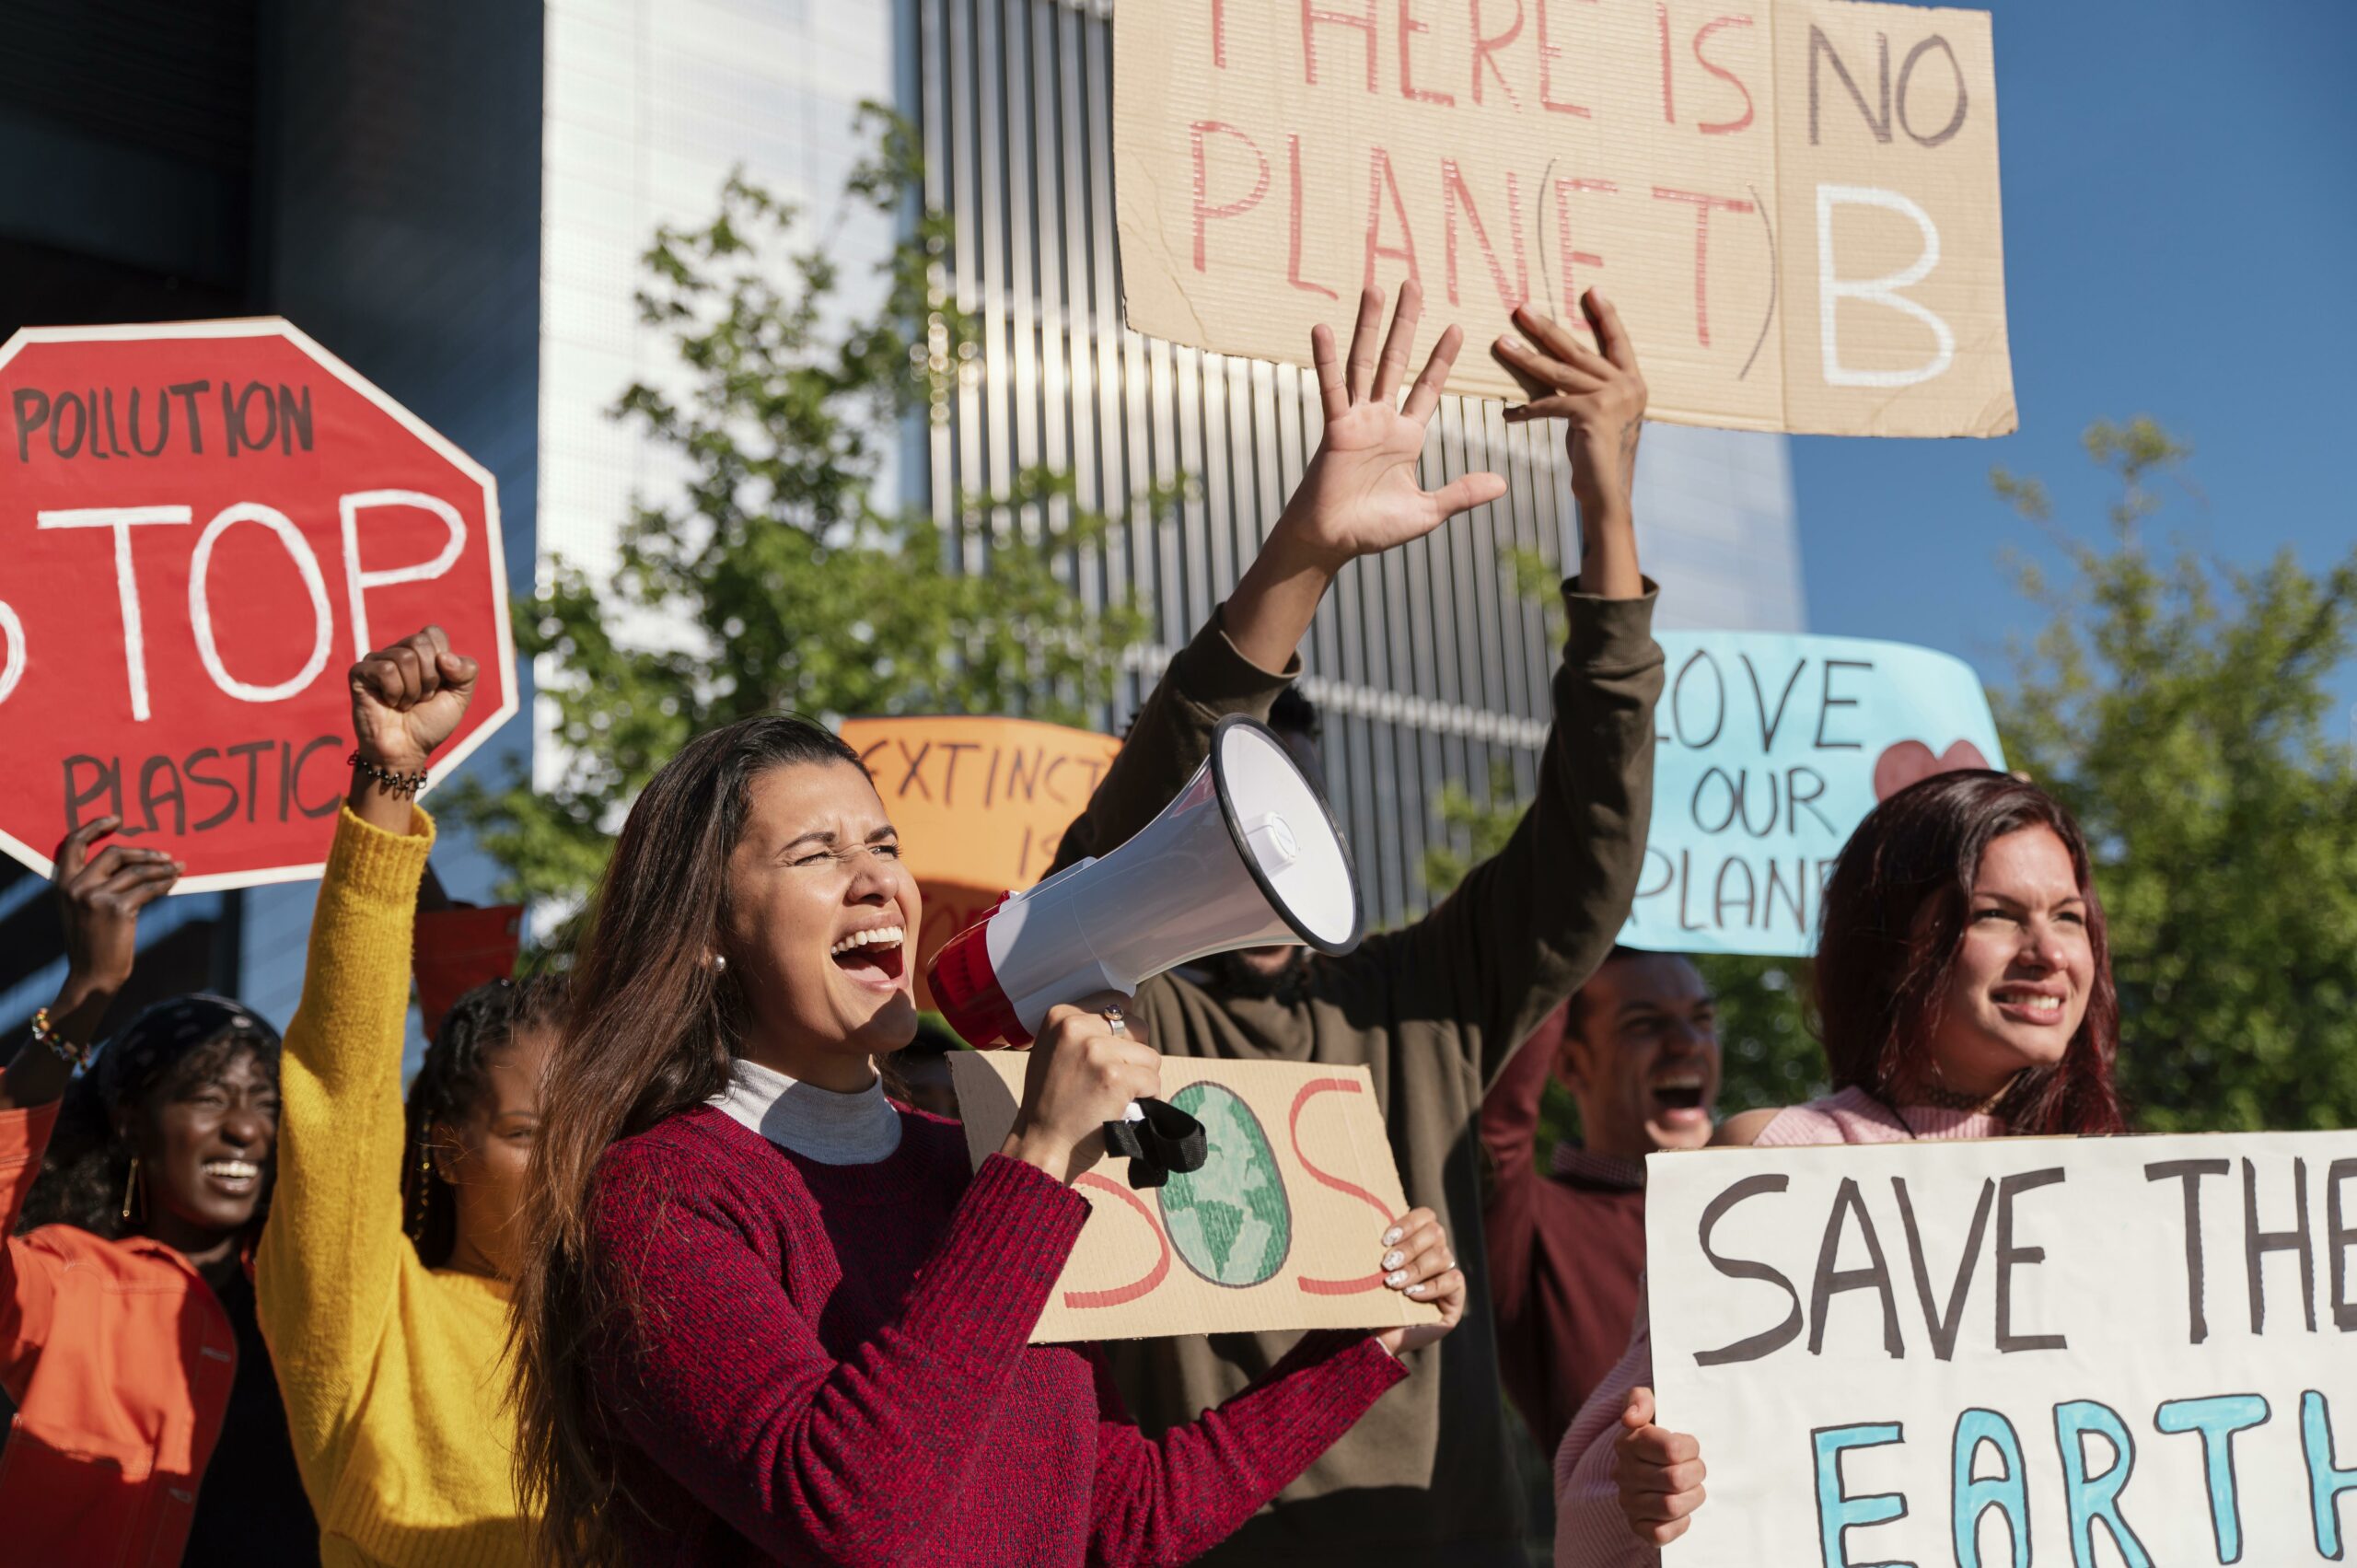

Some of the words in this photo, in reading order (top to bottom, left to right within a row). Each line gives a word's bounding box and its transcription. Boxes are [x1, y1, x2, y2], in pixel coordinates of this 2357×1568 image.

[1656, 0, 1755, 134] IS
[1807, 24, 1968, 147] NO
[1816, 184, 1956, 388] B
[14, 380, 314, 462] POLLUTION
[0, 490, 467, 722] TOP
[1655, 649, 1874, 753] OVE
[63, 737, 343, 835] PLASTIC
[1691, 767, 1839, 838] OUR
[1694, 1167, 2067, 1366] SAVE
[2144, 1156, 2357, 1344] THE
